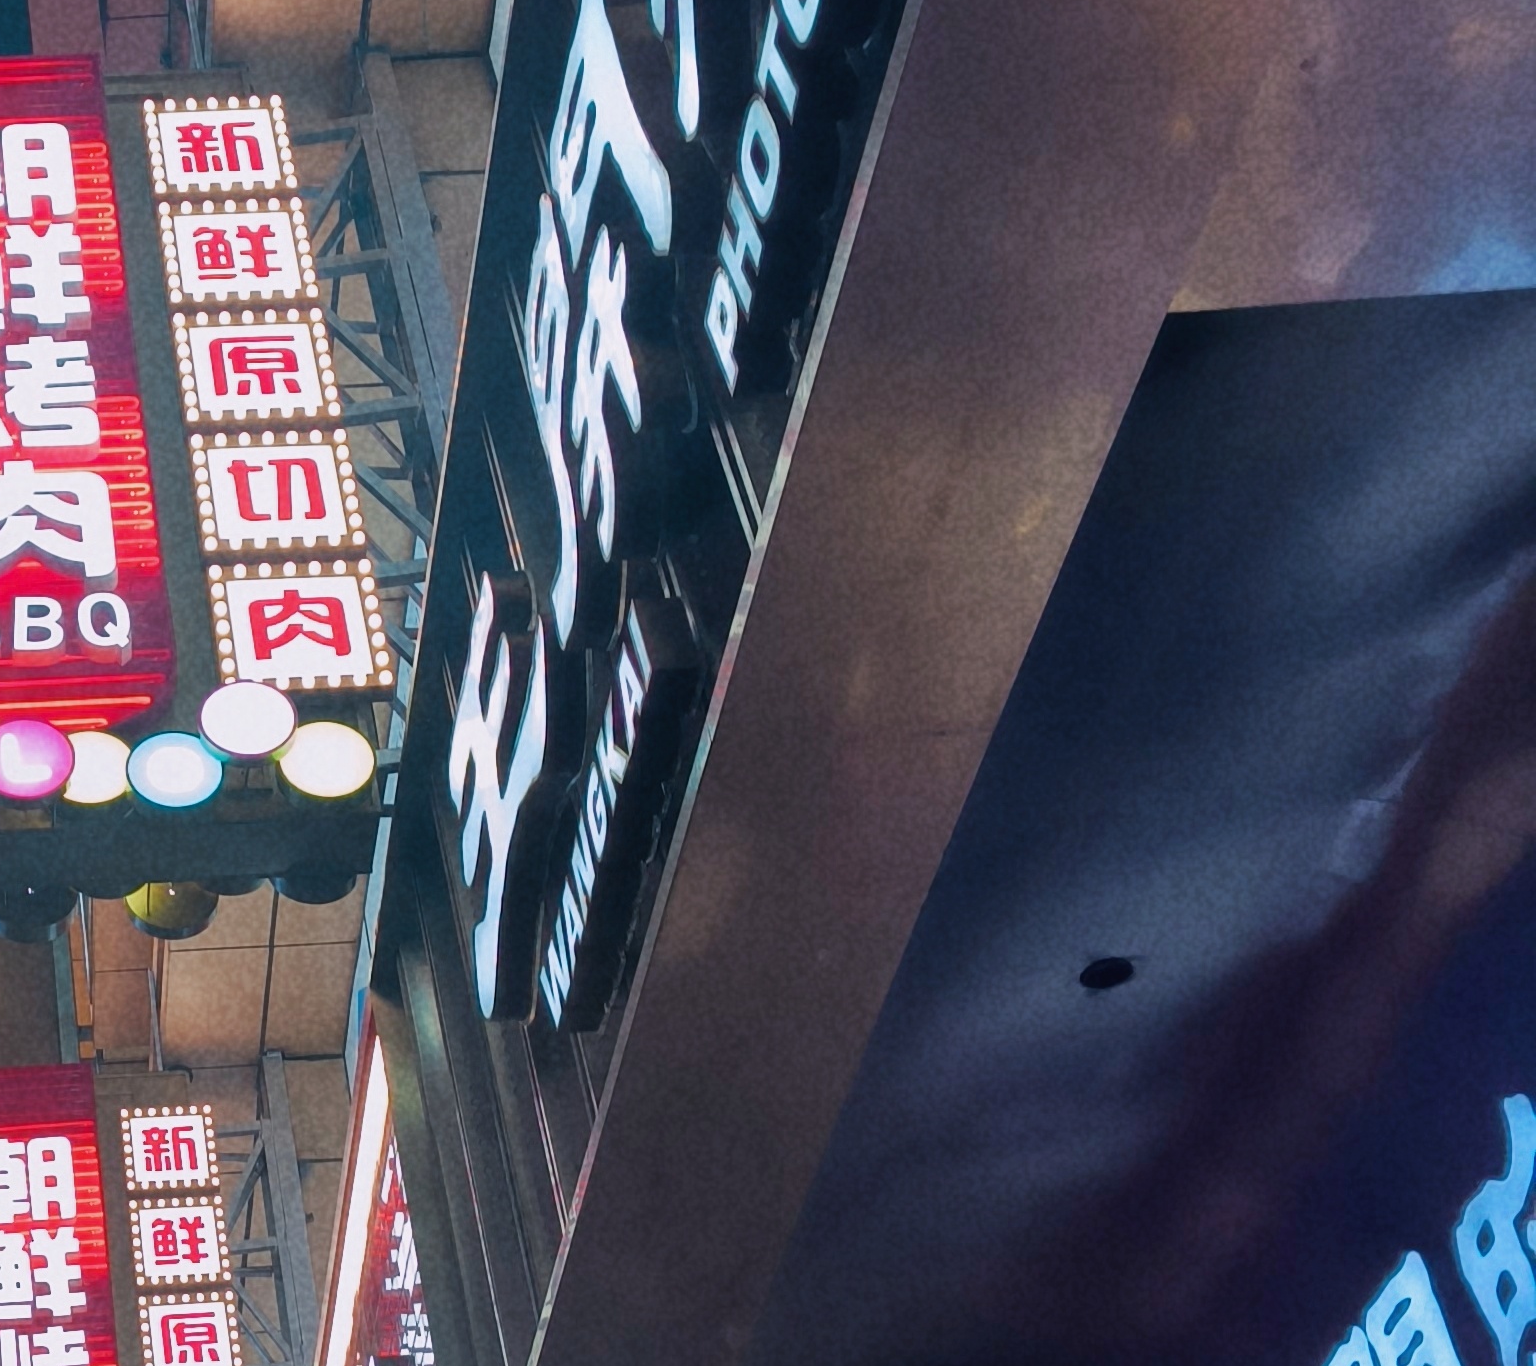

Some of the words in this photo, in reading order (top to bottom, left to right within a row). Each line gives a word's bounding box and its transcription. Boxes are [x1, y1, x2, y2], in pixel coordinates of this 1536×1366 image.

[176, 120, 352, 661] 新鲜原切肉
[540, 601, 653, 1029] WANGKAI
